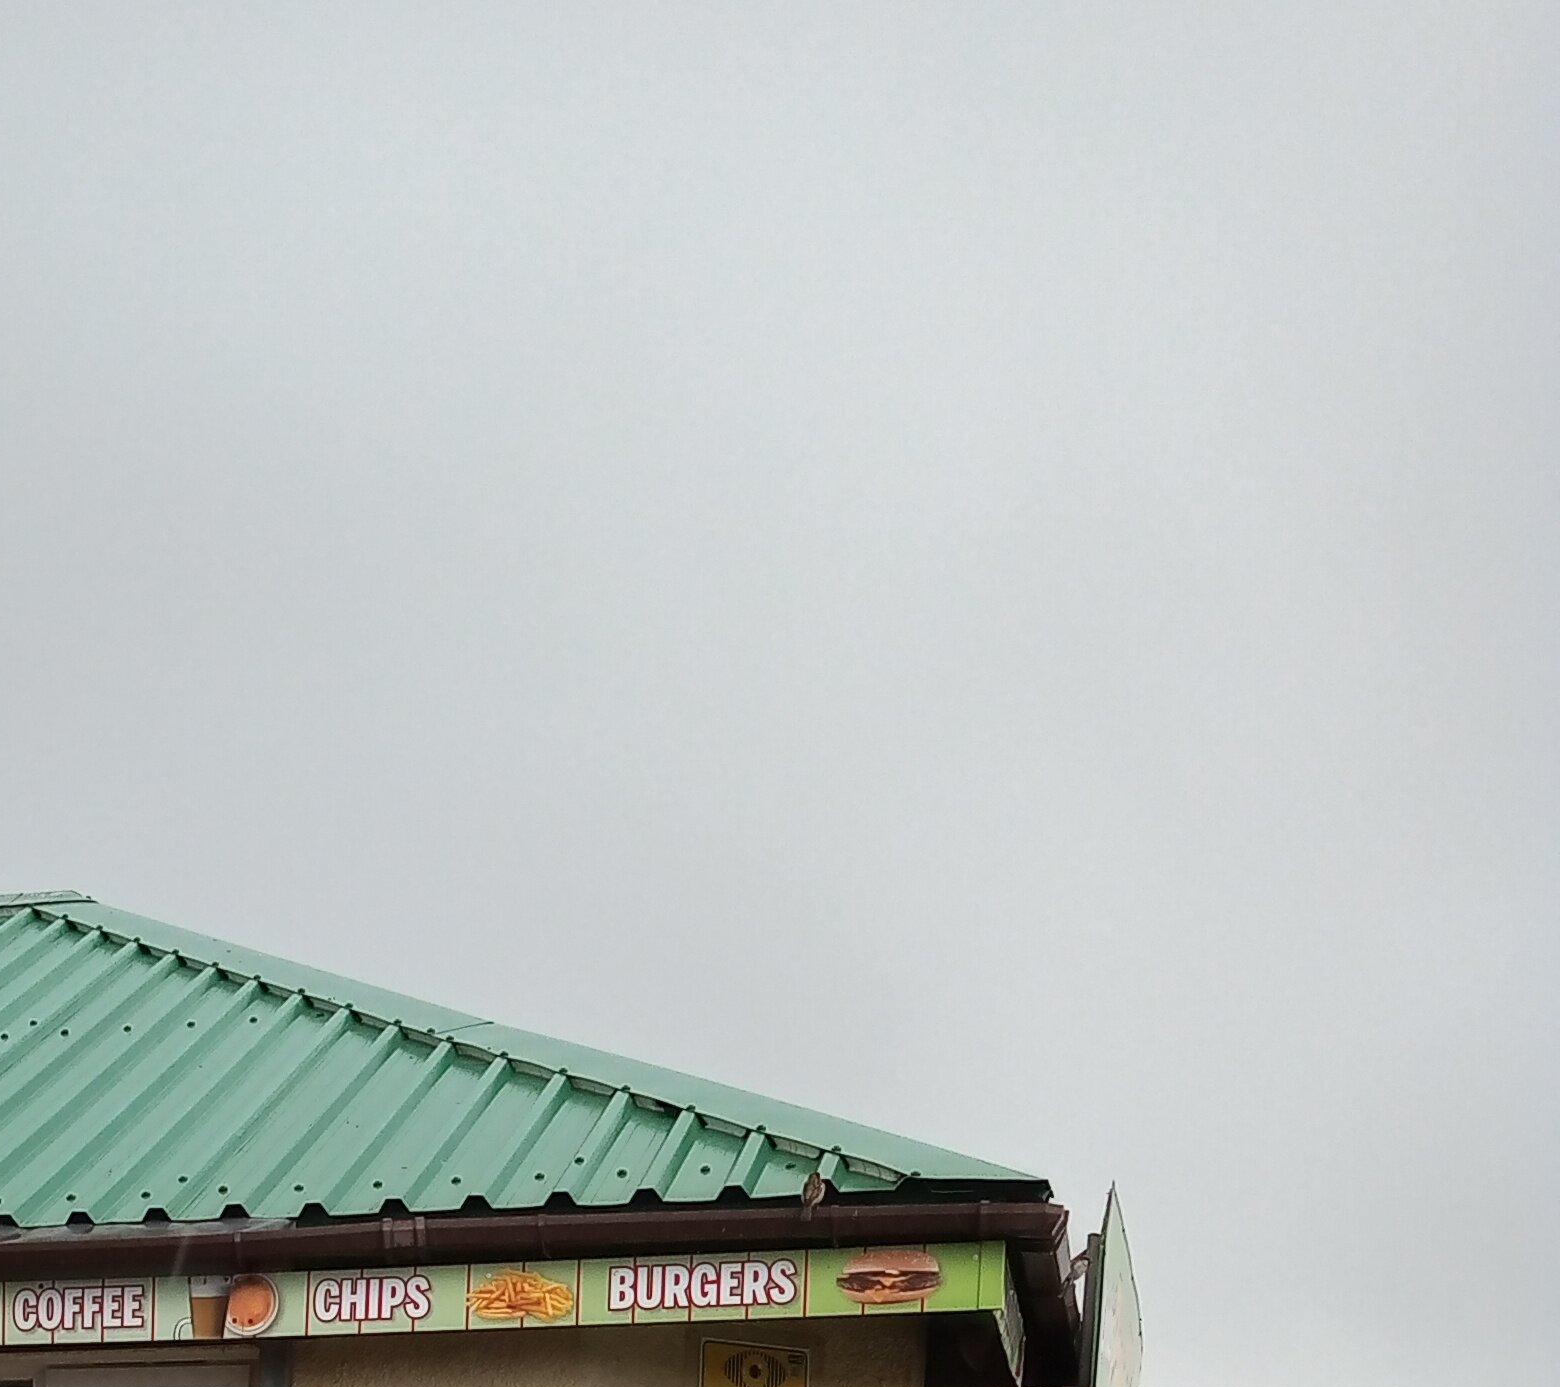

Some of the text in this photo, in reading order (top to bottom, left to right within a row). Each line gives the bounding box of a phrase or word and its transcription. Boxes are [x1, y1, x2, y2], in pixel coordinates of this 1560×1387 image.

[11, 1283, 145, 1331] COFFEE
[313, 1275, 431, 1323] CHIPS
[608, 1262, 798, 1311] BURGERS
